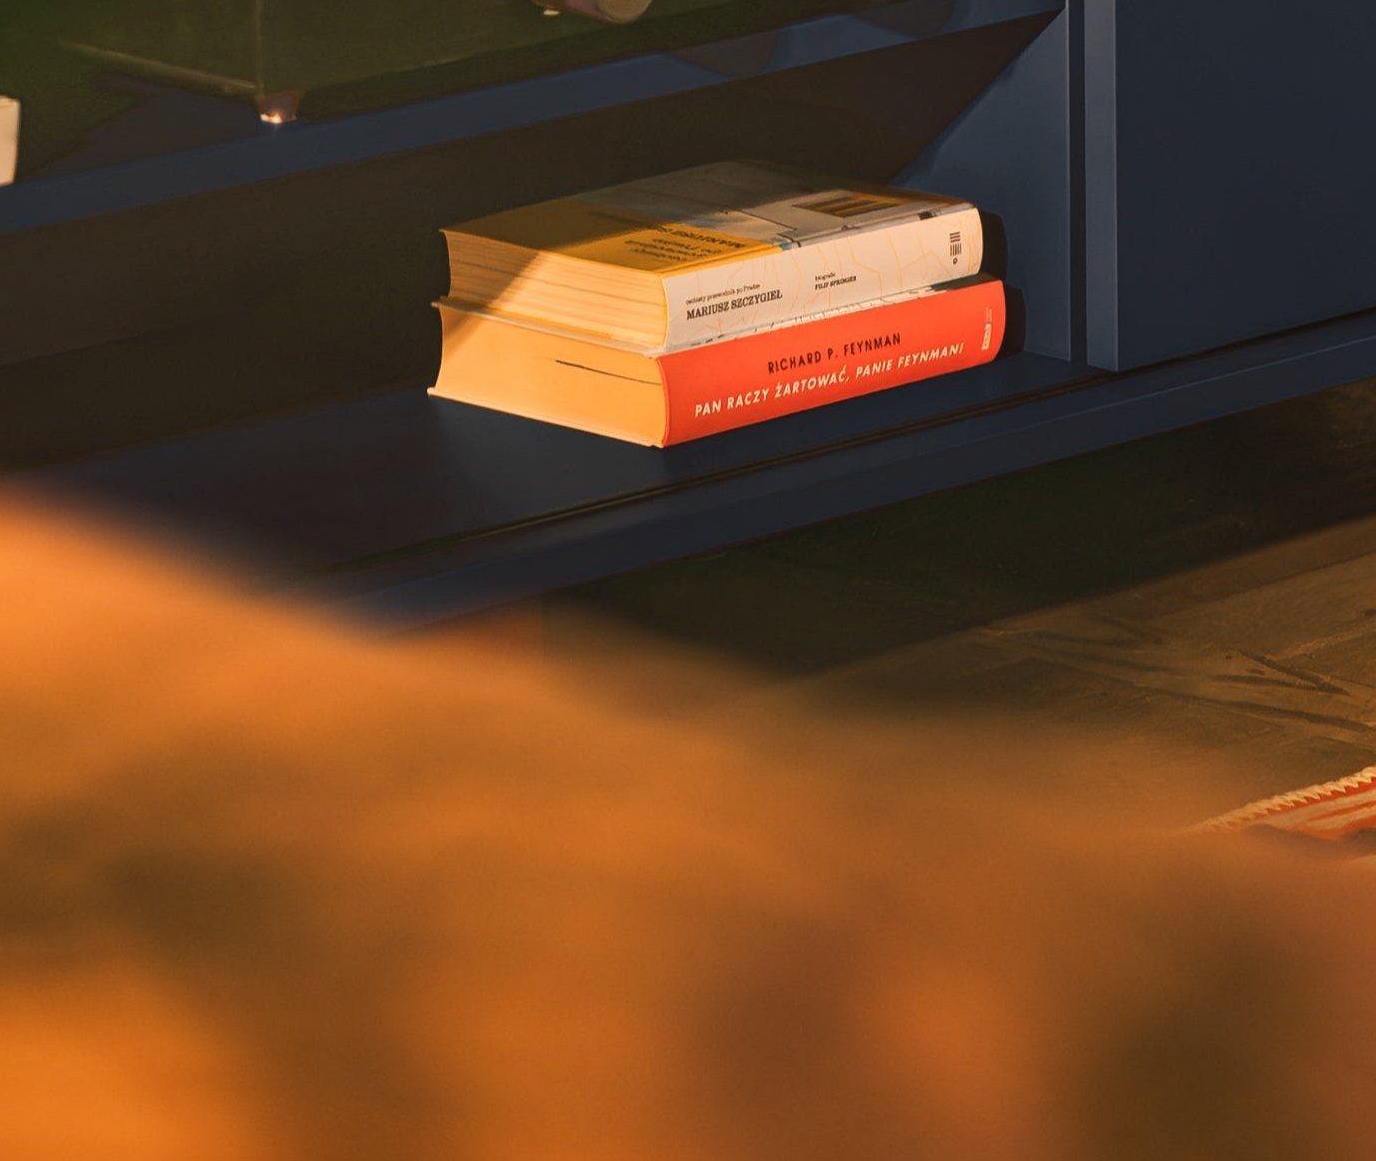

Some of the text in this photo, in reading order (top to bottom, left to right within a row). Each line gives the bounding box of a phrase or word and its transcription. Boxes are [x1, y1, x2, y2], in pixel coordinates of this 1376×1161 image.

[686, 289, 783, 320] MARIUSZ SZCZYGIEŁ
[766, 332, 902, 375] RICHARD P. FEYNMAN
[694, 341, 965, 418] PAN RACZY ŻARTOWAĆ, PANIE FEYNMAN!
